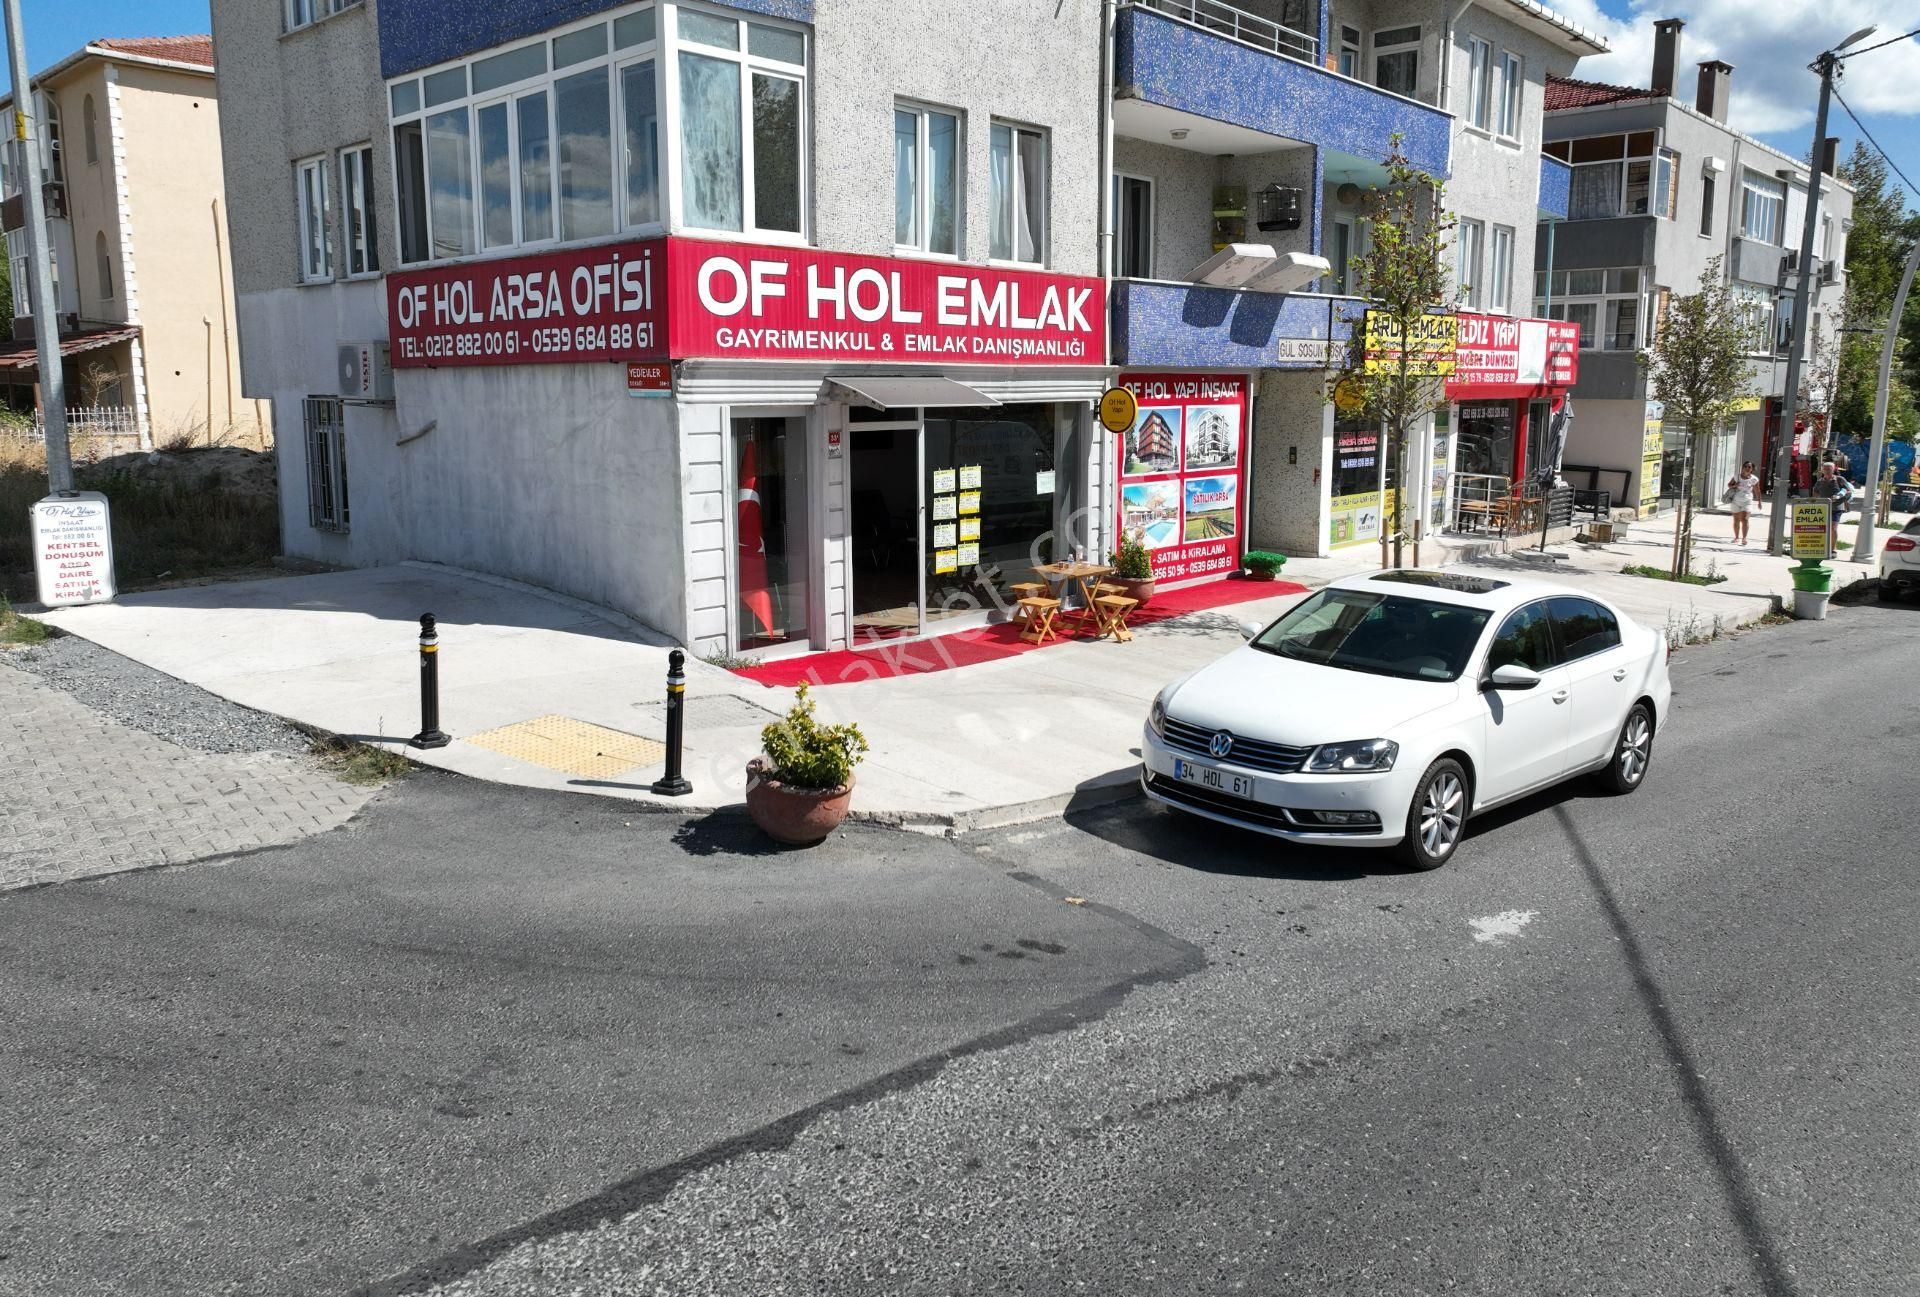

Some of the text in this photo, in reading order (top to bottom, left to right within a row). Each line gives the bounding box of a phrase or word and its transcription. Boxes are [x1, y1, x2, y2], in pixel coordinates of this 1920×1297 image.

[398, 248, 653, 328] OF HOL ARSA OFİSİ
[697, 256, 1093, 332] OF HOL EMLAK
[398, 337, 424, 358] TEL:
[425, 335, 454, 357] 0212
[456, 334, 481, 356] 882
[484, 332, 503, 354] 00
[505, 331, 520, 353] 61
[532, 328, 570, 352] 0539
[574, 325, 606, 350] 684
[610, 323, 633, 349] 88
[636, 322, 654, 348] 61
[881, 333, 895, 351] &
[904, 334, 968, 353] EMLAK
[972, 337, 1085, 359] DANIŞMANLIĞI
[1493, 321, 1519, 348] YAPI
[1279, 341, 1296, 358] GÜL
[1145, 381, 1172, 400] HOL
[1173, 381, 1198, 399] YAPI
[1201, 378, 1240, 401] İNŞAAT
[47, 541, 100, 550] KENTSEL
[1156, 550, 1180, 564] SATIM
[1181, 550, 1187, 560] &
[54, 579, 100, 589] SATILIK
[1181, 762, 1248, 795] 34 HOL 61
